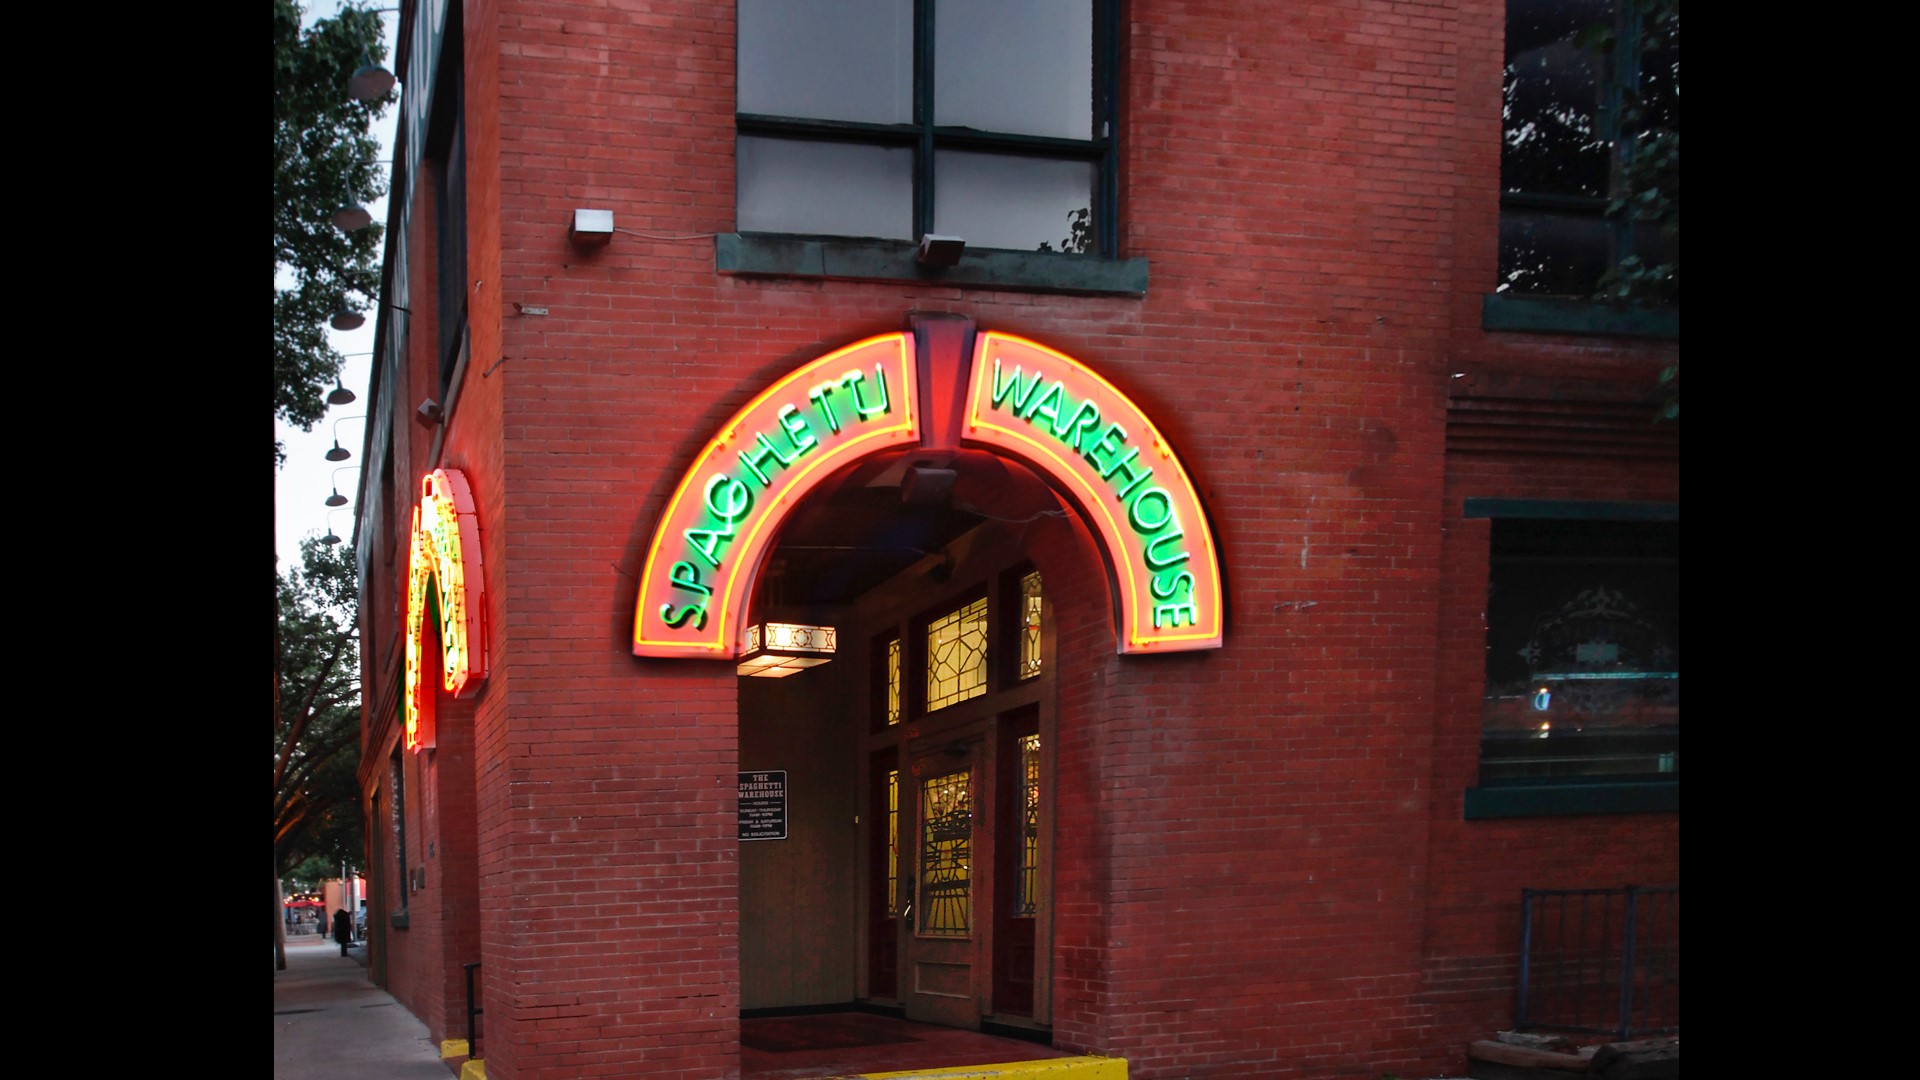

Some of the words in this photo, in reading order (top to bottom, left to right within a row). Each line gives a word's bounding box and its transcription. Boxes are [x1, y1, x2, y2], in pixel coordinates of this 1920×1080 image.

[659, 362, 892, 632] SPAGHETTI
[990, 357, 1197, 629] WAREHOUSE
[753, 774, 769, 782] THE
[739, 782, 782, 791] SPAGHETTI
[738, 790, 784, 799] WAREHOUSE
